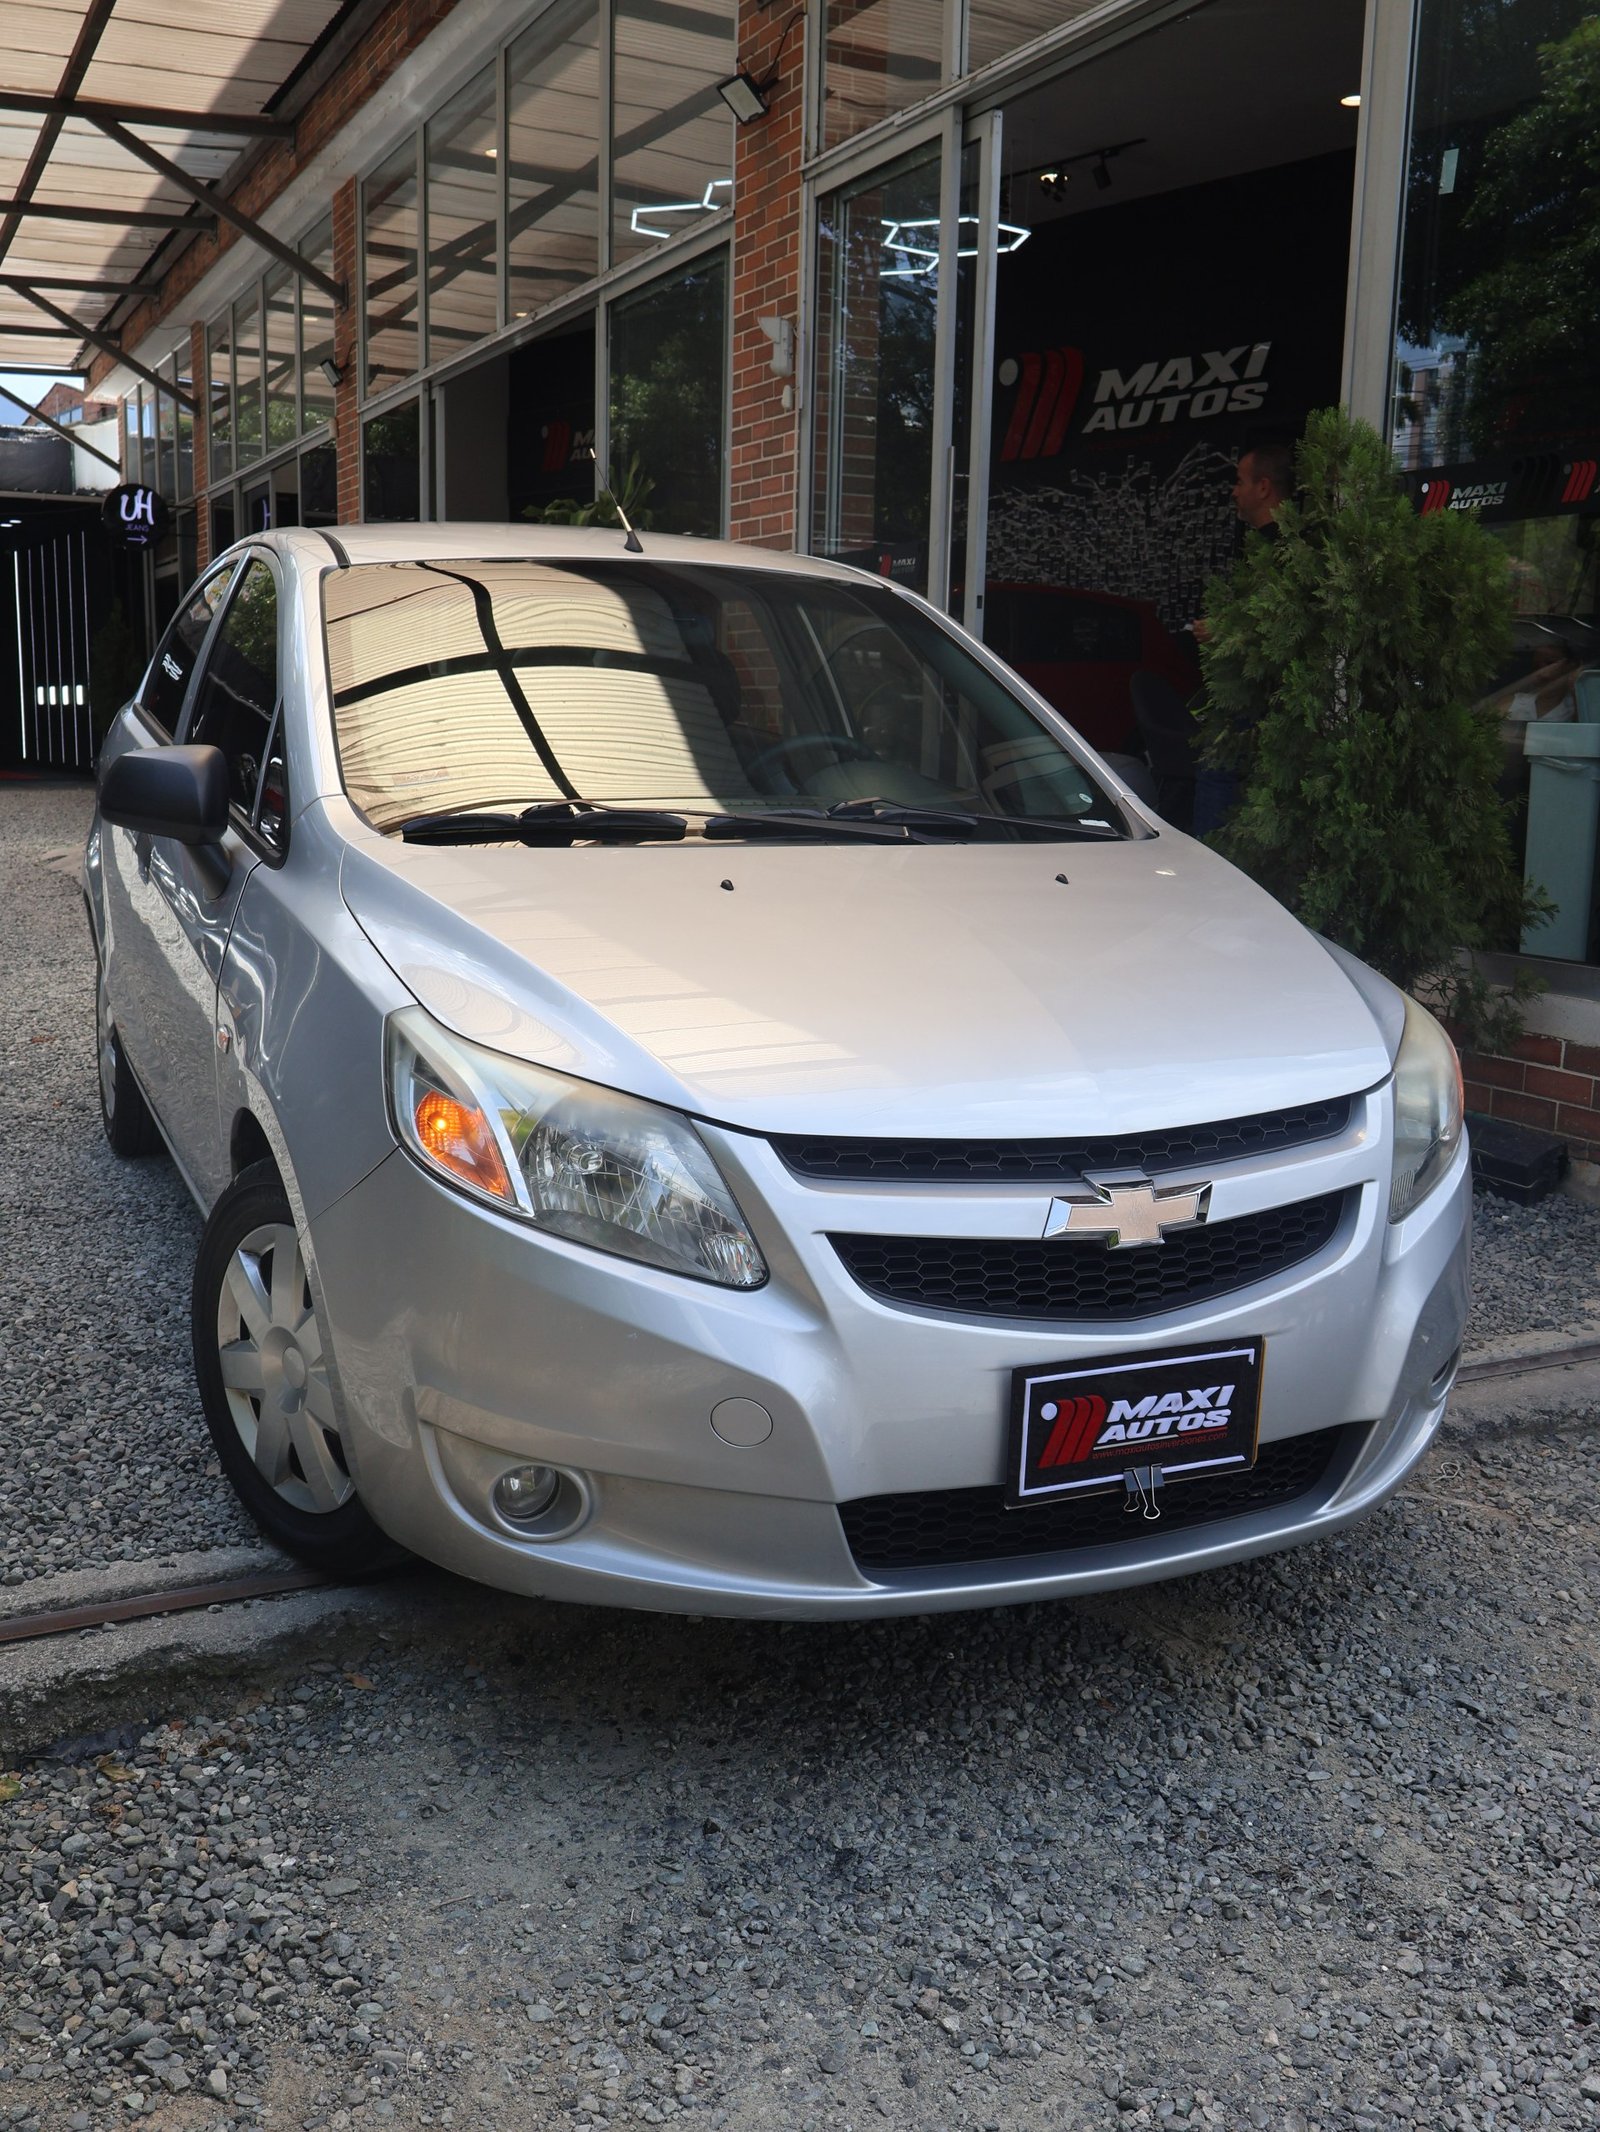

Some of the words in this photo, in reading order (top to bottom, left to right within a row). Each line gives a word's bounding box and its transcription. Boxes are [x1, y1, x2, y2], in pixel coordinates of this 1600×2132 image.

[1093, 341, 1272, 403] MAXI
[1081, 382, 1269, 434] AUTOS
[120, 488, 154, 525] UH
[1448, 495, 1505, 511] AUTOS
[1451, 482, 1507, 500] MAXI
[1106, 1384, 1235, 1423] MAXI
[1097, 1409, 1232, 1444] AUTOS
[1092, 1433, 1228, 1459] www.maxiautosinversiones.com
